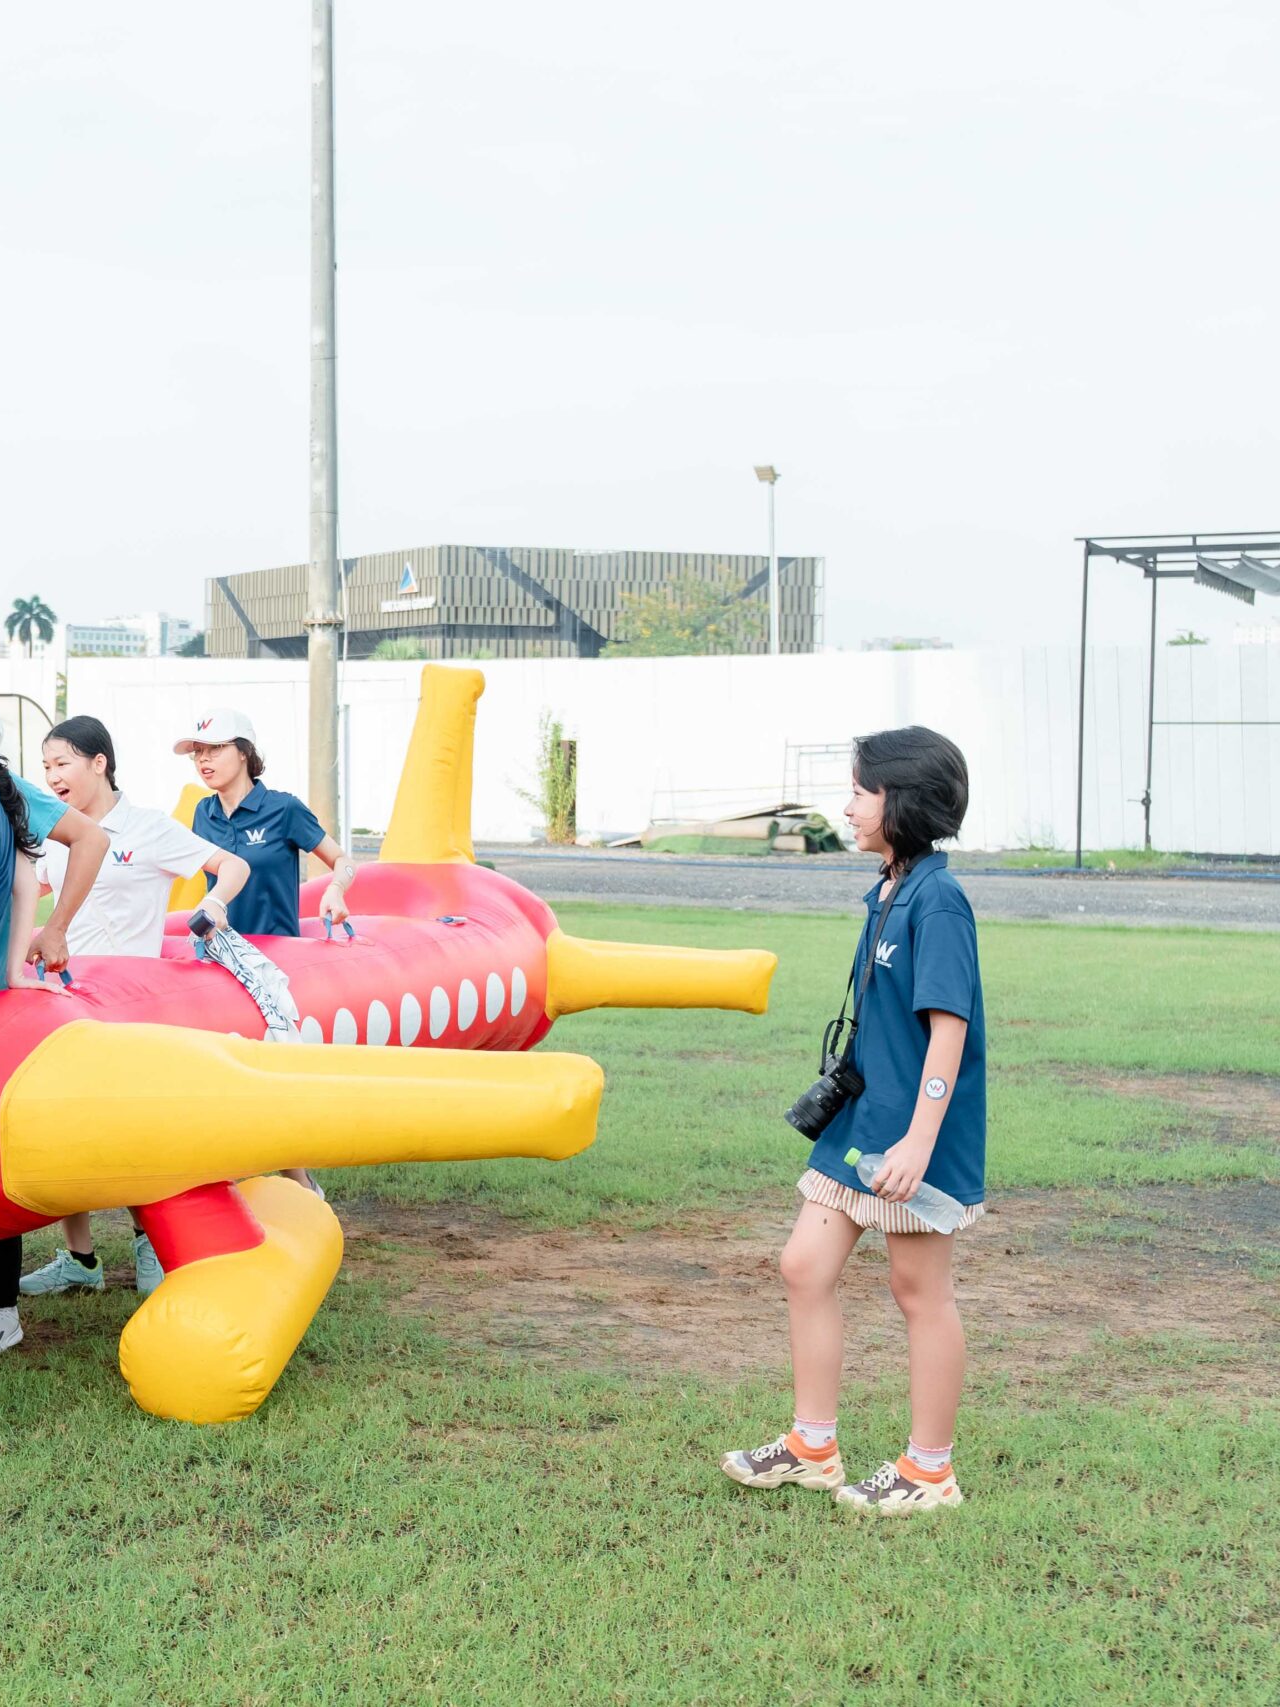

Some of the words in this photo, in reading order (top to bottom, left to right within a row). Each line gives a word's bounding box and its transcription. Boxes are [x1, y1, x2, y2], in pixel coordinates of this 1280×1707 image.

[197, 718, 213, 731] W
[245, 828, 266, 841] W
[112, 850, 133, 862] W
[876, 939, 898, 961] W
